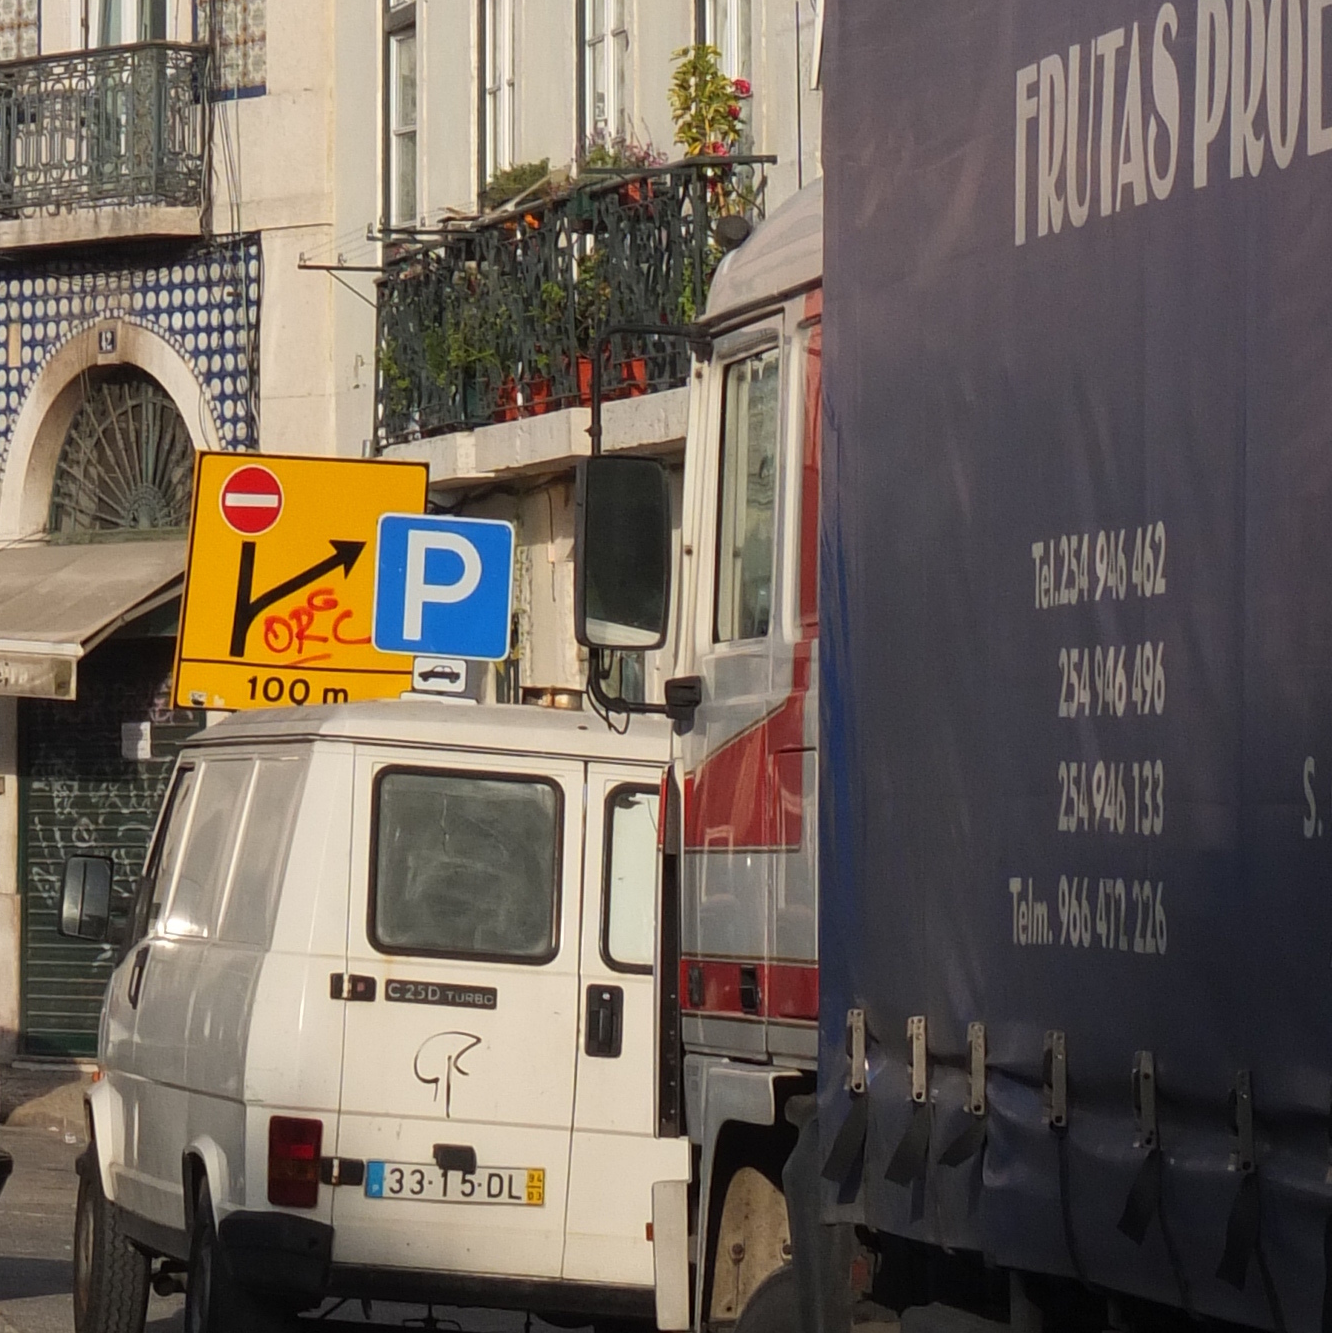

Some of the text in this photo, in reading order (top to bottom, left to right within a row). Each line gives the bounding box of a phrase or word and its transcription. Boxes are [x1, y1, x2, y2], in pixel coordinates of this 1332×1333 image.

[1015, 2, 1180, 247] FRUTAS
[403, 529, 482, 641] P
[1094, 529, 1127, 601] 946
[1132, 520, 1167, 598] 462
[248, 675, 349, 706] 100 m
[1058, 640, 1166, 719] 254 946 496
[1058, 758, 1164, 835] 254 946 133
[1009, 874, 1167, 955] Telm. 966 472 226
[388, 982, 495, 1006] C 25D TURBO
